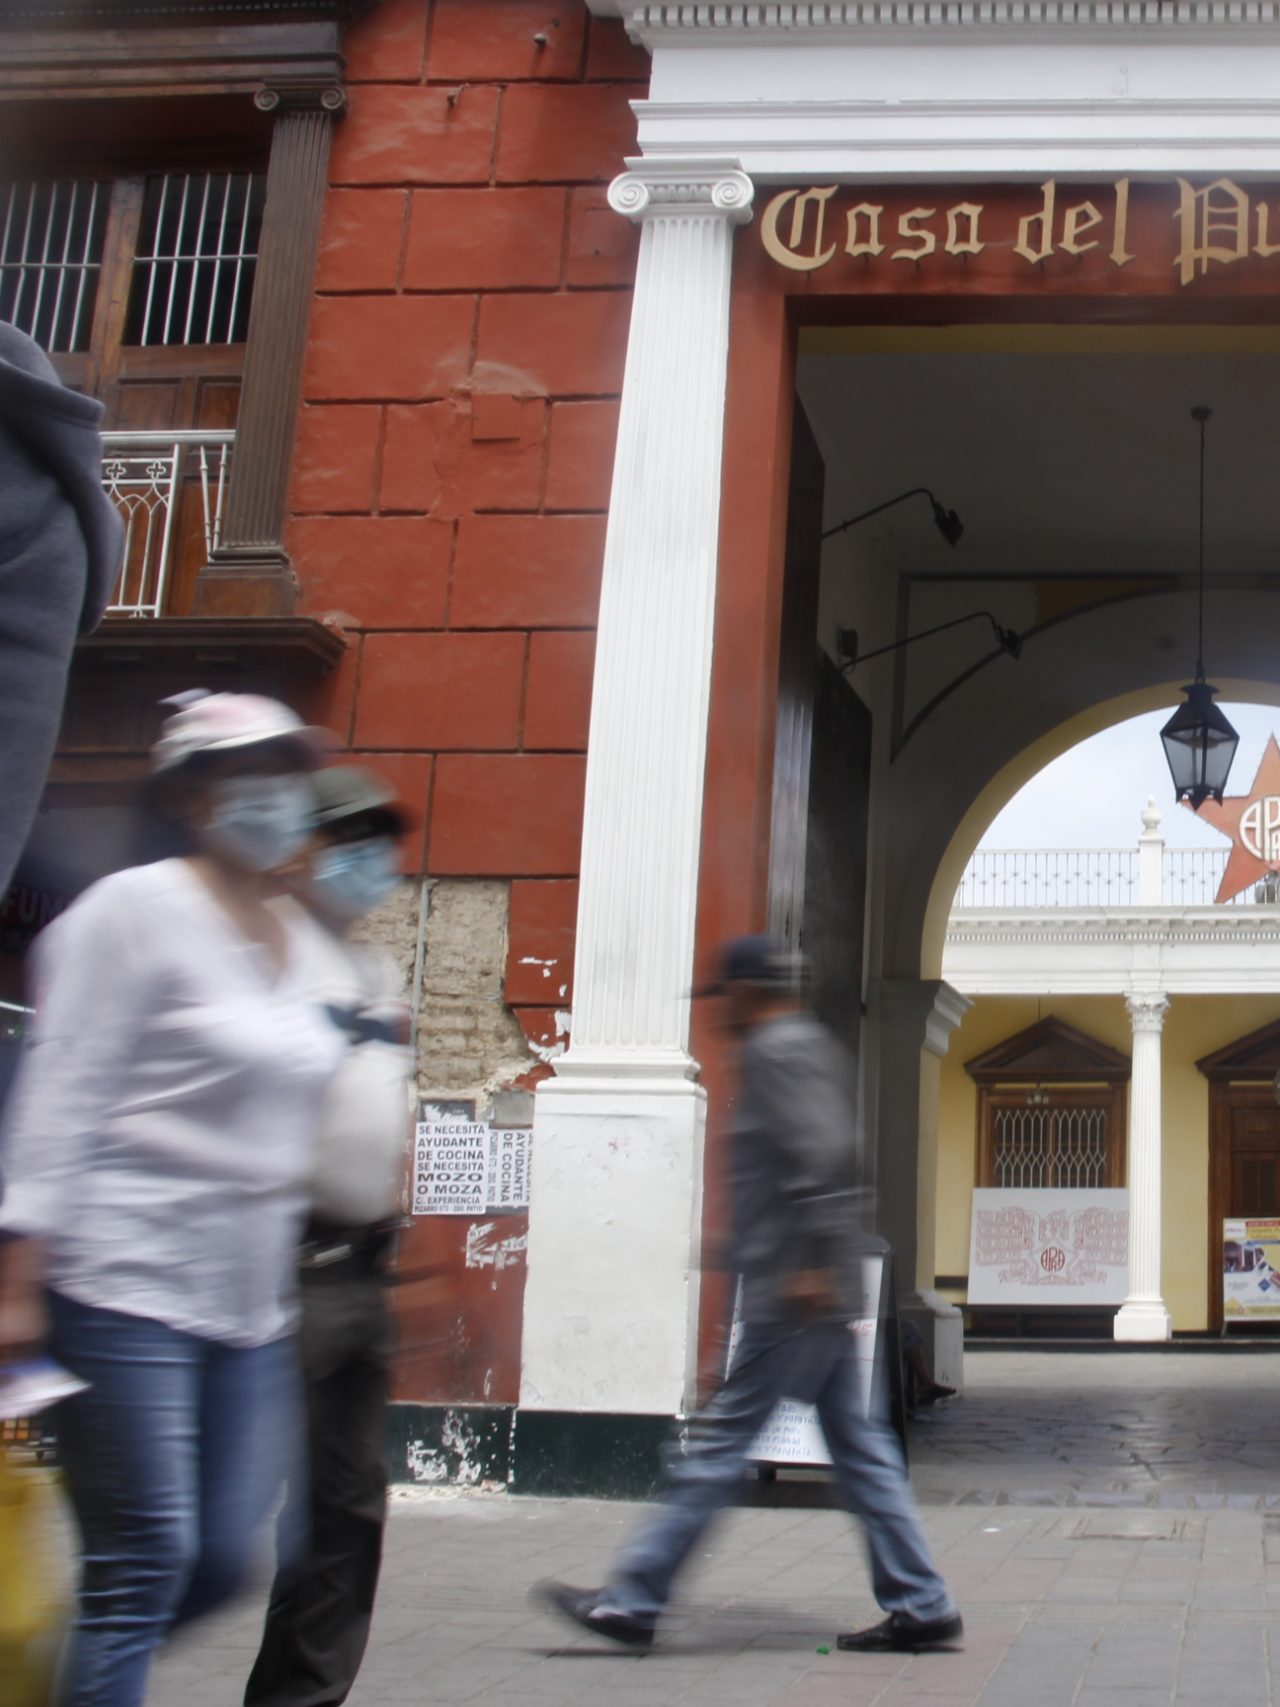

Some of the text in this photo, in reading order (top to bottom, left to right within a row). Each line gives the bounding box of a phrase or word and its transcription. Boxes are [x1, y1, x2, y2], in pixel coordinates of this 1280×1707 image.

[761, 184, 986, 272] Casa
[1013, 177, 1136, 267] del
[420, 1125, 485, 1134] SE NECESITA
[418, 1137, 483, 1147] AYUDANTE
[418, 1150, 484, 1160] DE COCINA
[417, 1162, 484, 1171] SE NECESITA
[500, 1133, 513, 1202] DE COCINA
[513, 1132, 526, 1201] AYUDANTE
[417, 1173, 483, 1182] MOZO
[417, 1184, 482, 1195] O MOZA
[427, 1196, 480, 1204] EXPERIENCIA
